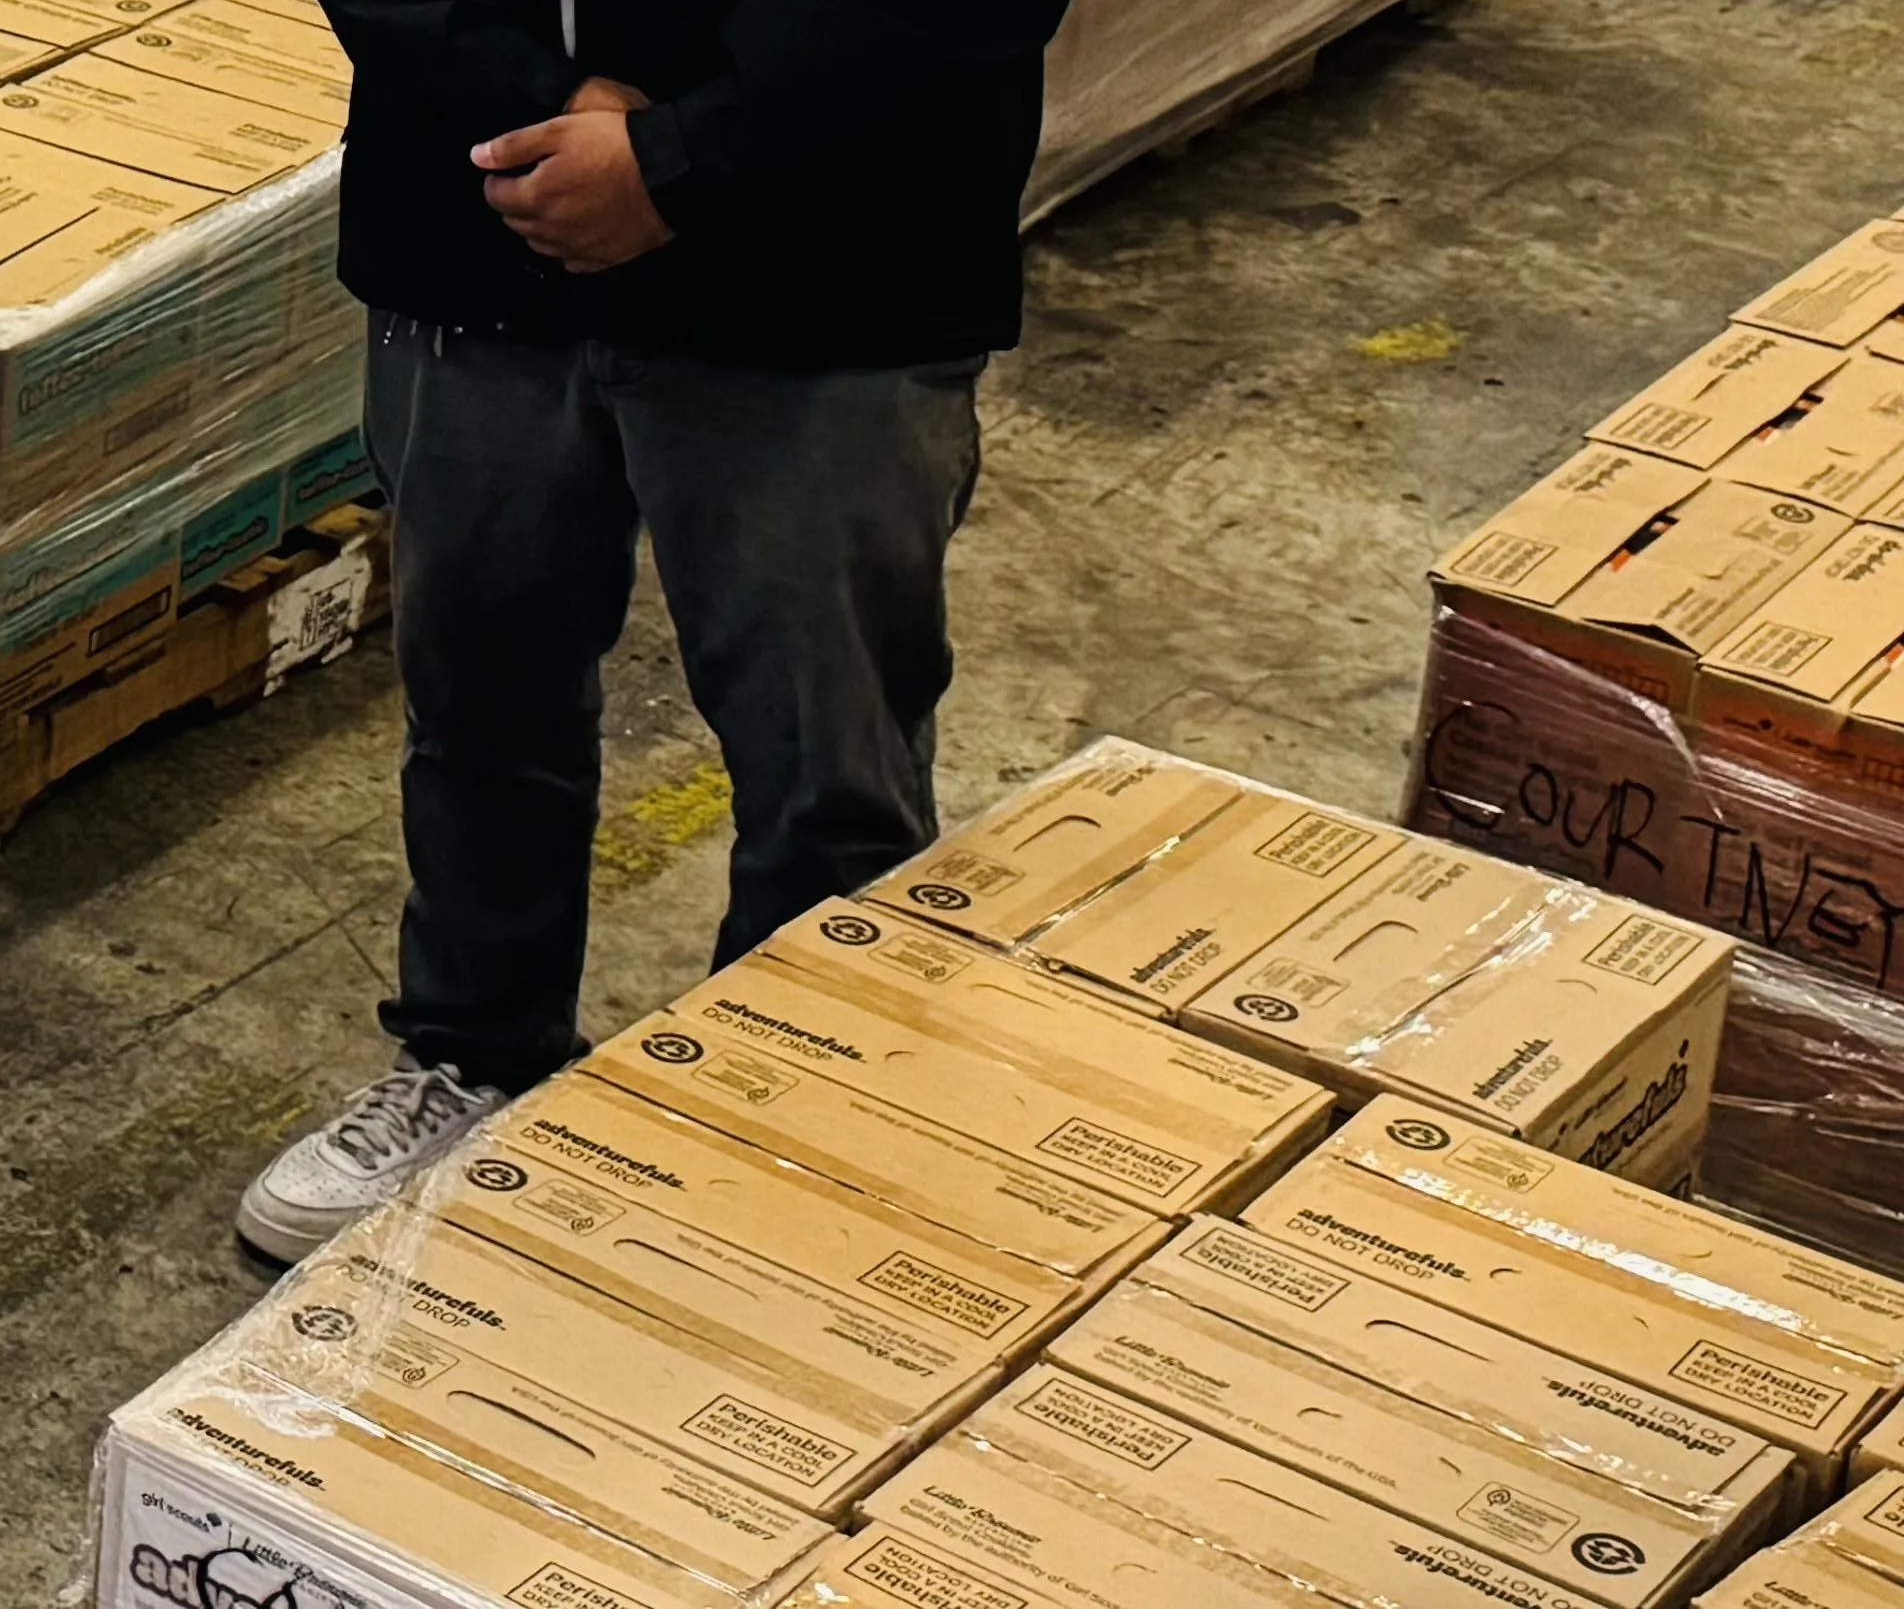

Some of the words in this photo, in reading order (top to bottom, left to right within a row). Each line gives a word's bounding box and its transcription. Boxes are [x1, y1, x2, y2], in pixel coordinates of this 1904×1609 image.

[1424, 702, 1904, 990] COURTNEY
[700, 1006, 734, 1025] DO
[735, 1019, 780, 1041] NOT
[778, 1033, 835, 1063] DROP
[714, 998, 862, 1061] adventurefuls
[532, 1118, 684, 1189] adventurefuls
[1284, 1216, 1319, 1238] DO
[1324, 1231, 1371, 1257] NOT
[1372, 1250, 1434, 1282] DROP
[1295, 1206, 1467, 1281] adventurefuls
[696, 1420, 732, 1444] DRY
[733, 1435, 817, 1478] LOCATION
[706, 1411, 747, 1435] KEEP
[745, 1428, 766, 1444] IN
[783, 1444, 823, 1472] COOL
[718, 1400, 838, 1463] Perishable
